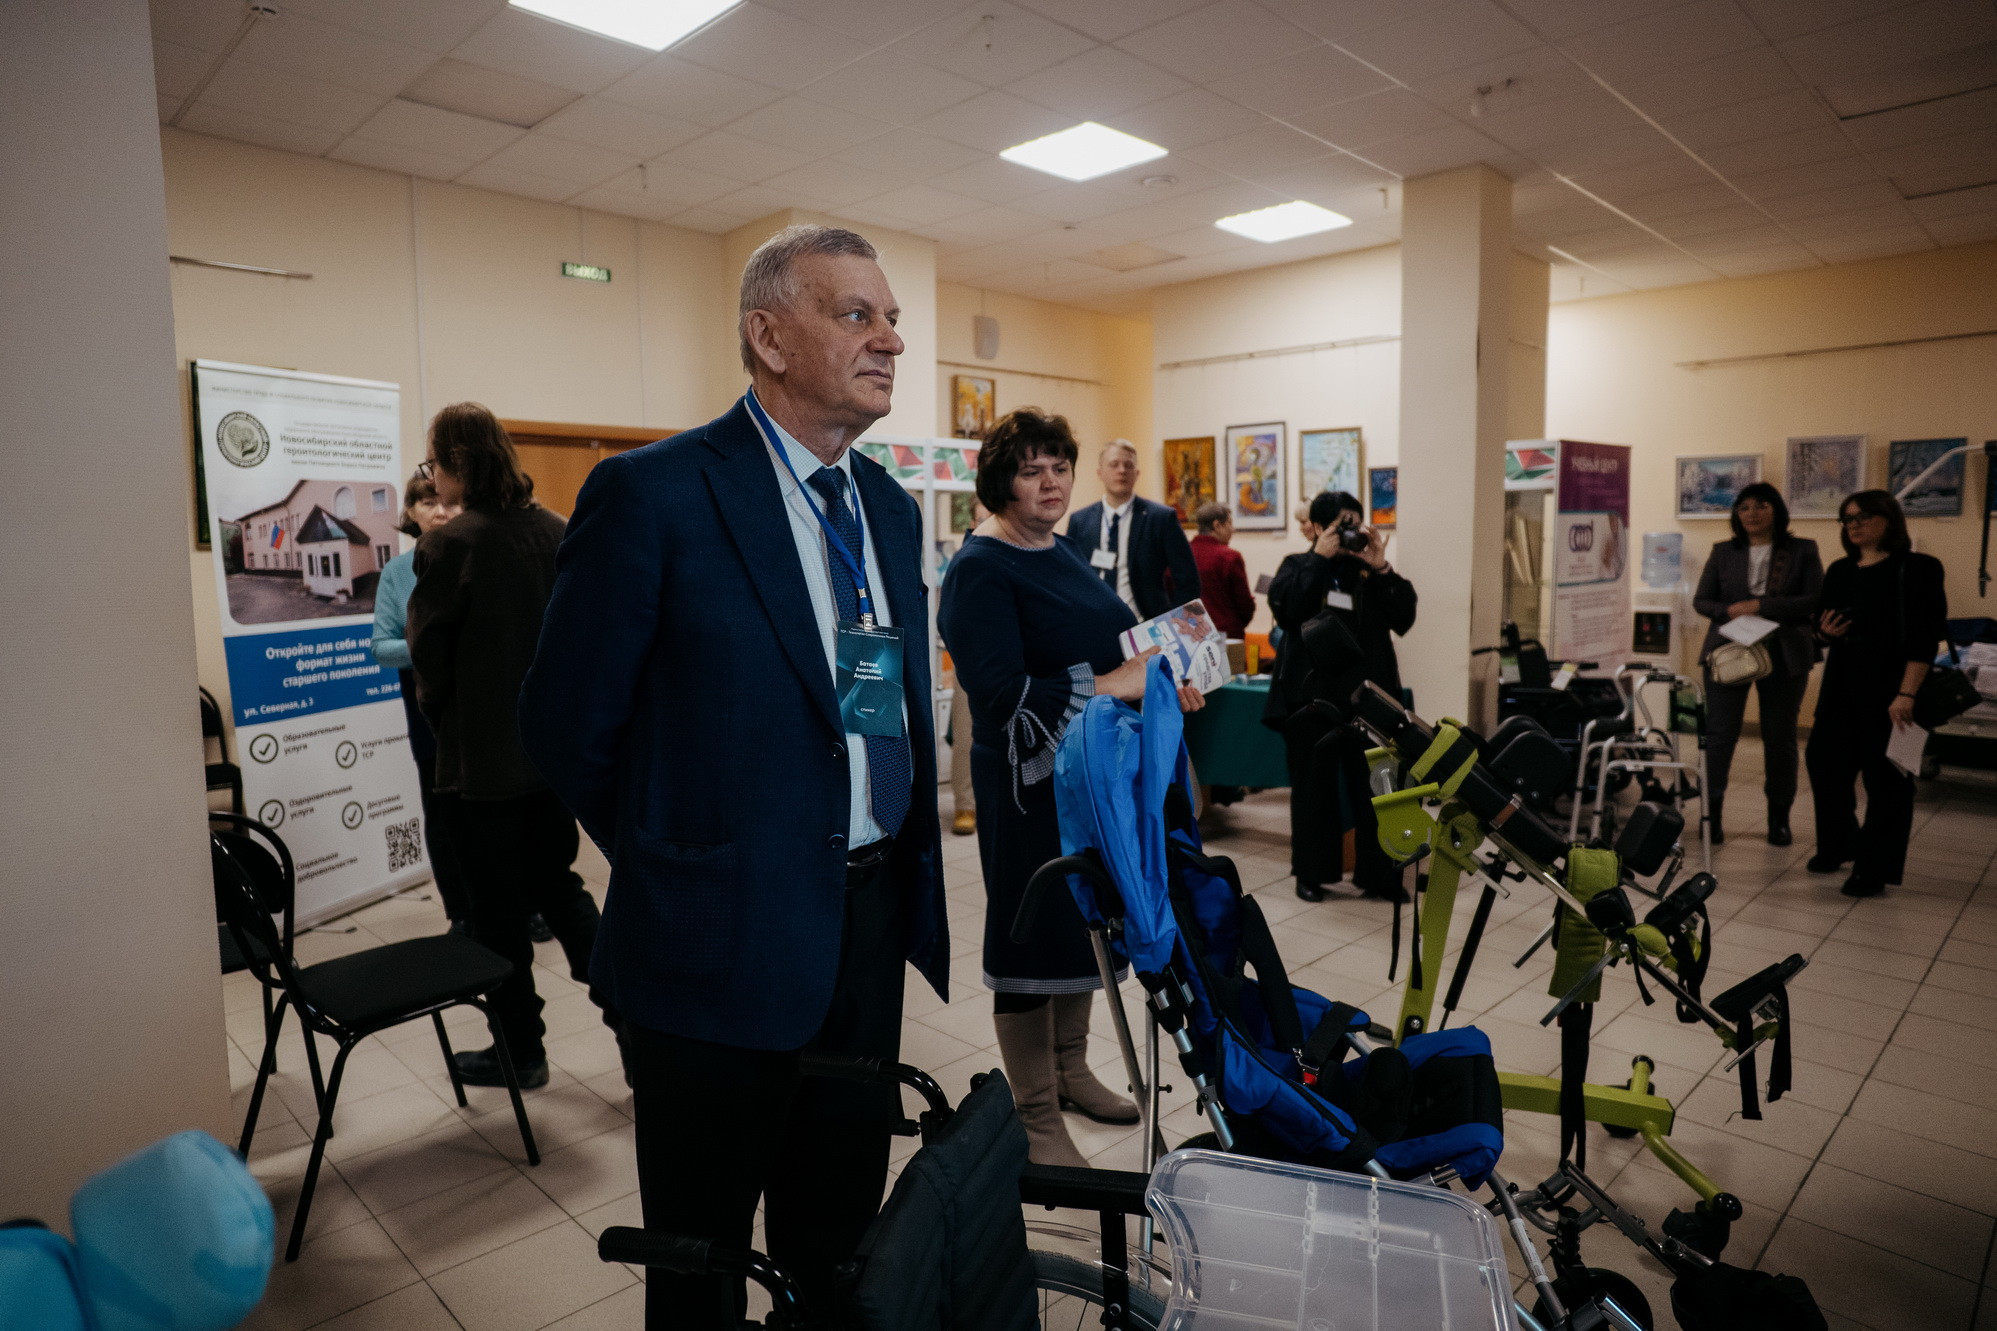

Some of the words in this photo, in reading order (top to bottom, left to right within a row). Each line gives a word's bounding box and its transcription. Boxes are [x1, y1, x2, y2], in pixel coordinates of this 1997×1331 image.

[565, 263, 608, 281] ВЫХОД
[280, 433, 348, 447] Новосибирский
[349, 439, 393, 450] областной
[265, 643, 314, 659] Откройте
[316, 644, 333, 655] для
[335, 637, 356, 650] себя
[358, 637, 372, 648] но
[295, 658, 333, 672] формат
[335, 652, 366, 664] жизни
[855, 666, 882, 674] Анатолий
[282, 672, 328, 688] старшего
[329, 664, 381, 680] поколения
[853, 673, 884, 681] Андреевич
[243, 707, 259, 719] ул.
[282, 724, 346, 743] Образовательные
[283, 743, 308, 756] услуги
[290, 806, 315, 820] услуги
